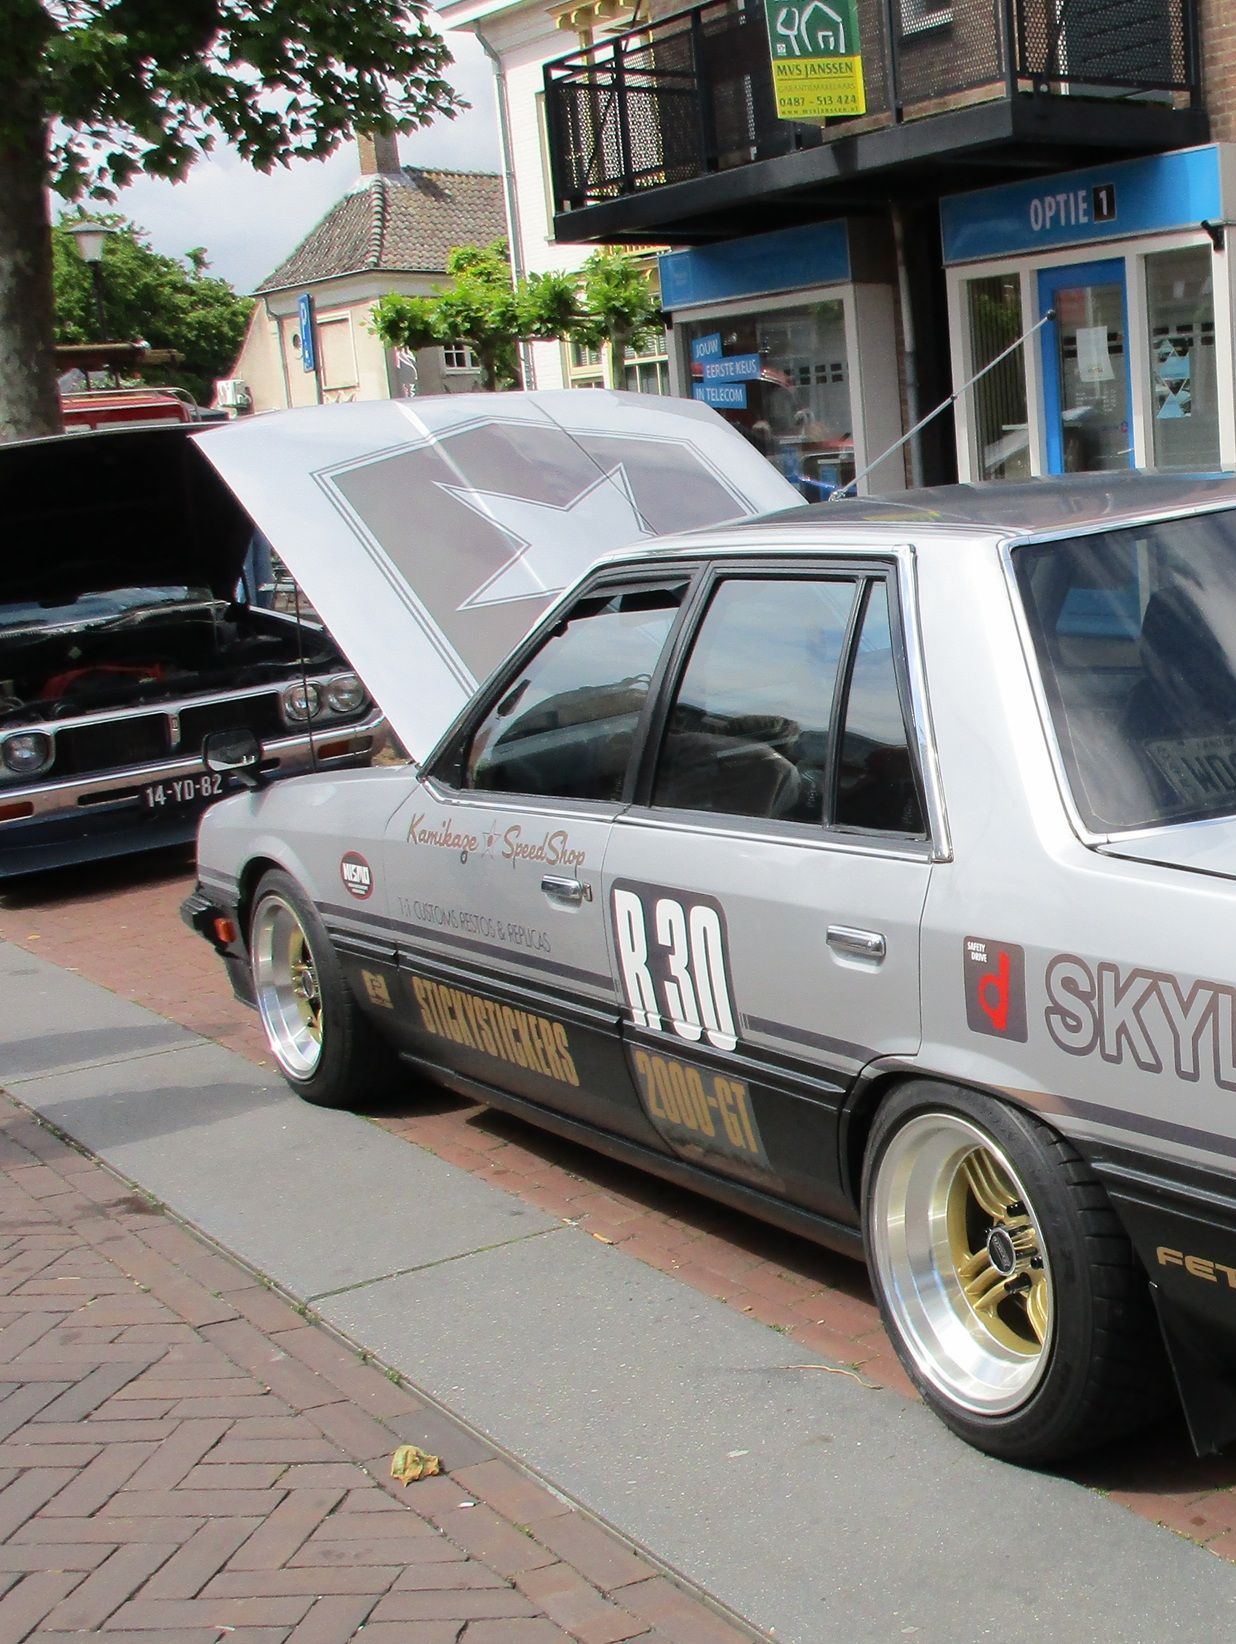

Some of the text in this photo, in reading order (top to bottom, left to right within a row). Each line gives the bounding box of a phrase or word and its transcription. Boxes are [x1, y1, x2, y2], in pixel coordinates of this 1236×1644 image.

[777, 62, 853, 78] MVS JANSSEN
[817, 95, 833, 105] 513
[837, 94, 856, 104] 424
[1030, 190, 1088, 231] OPTIE
[696, 339, 718, 358] JOUW
[706, 359, 757, 378] EERSTE KEUS
[706, 387, 743, 402] TELECOM
[146, 773, 223, 807] 14-YD-82
[407, 812, 479, 864] Kamikaze
[967, 941, 986, 953] SAFETY
[971, 951, 988, 963] DRIVE
[614, 888, 738, 1051] R30
[411, 975, 580, 1087] STICKYSTICKERS
[635, 1050, 759, 1154] 2000-GT
